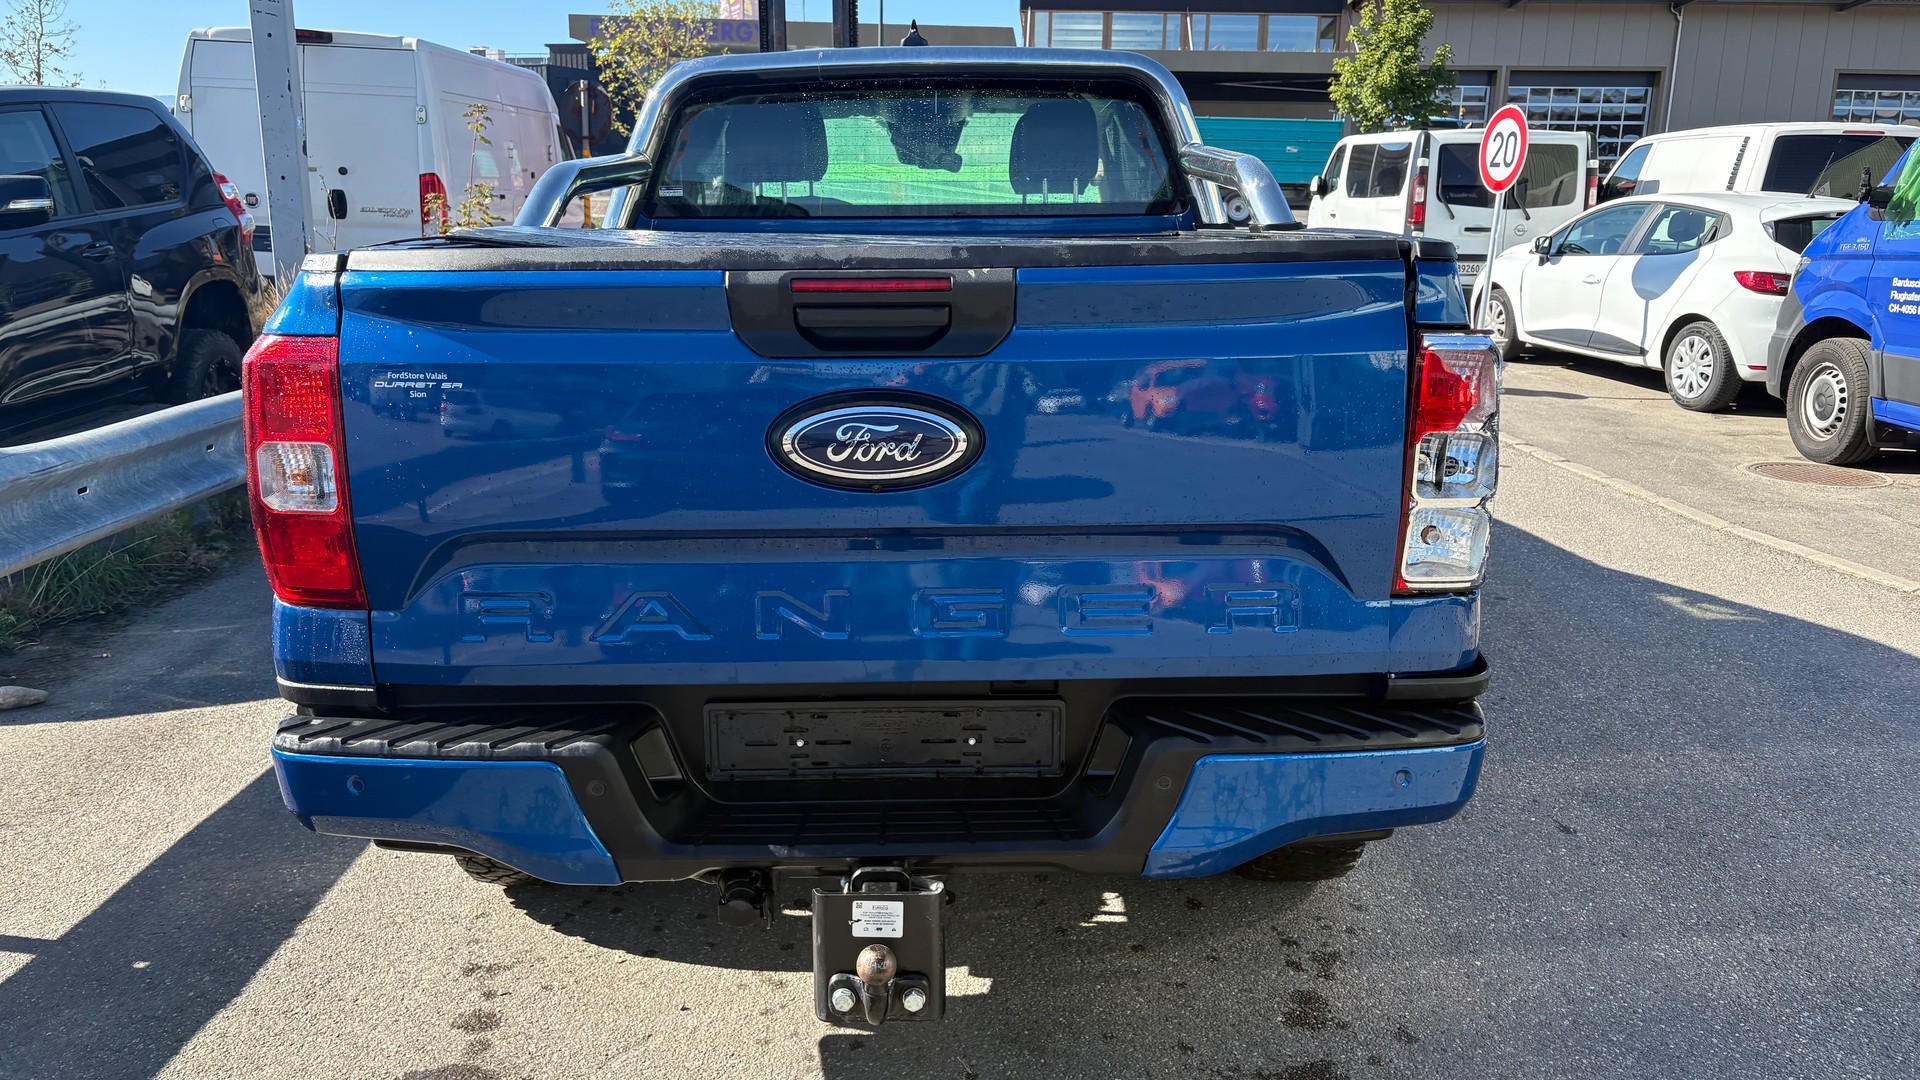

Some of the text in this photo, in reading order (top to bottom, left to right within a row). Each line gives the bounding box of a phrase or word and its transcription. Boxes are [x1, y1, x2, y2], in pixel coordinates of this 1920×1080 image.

[1489, 131, 1518, 168] 20
[1888, 303, 1917, 314] CH-4056
[387, 371, 448, 380] FordStore Valais
[374, 381, 437, 389] DURRET
[409, 390, 427, 398] Sion
[826, 422, 924, 462] Ford
[457, 583, 1300, 642] RANGER
